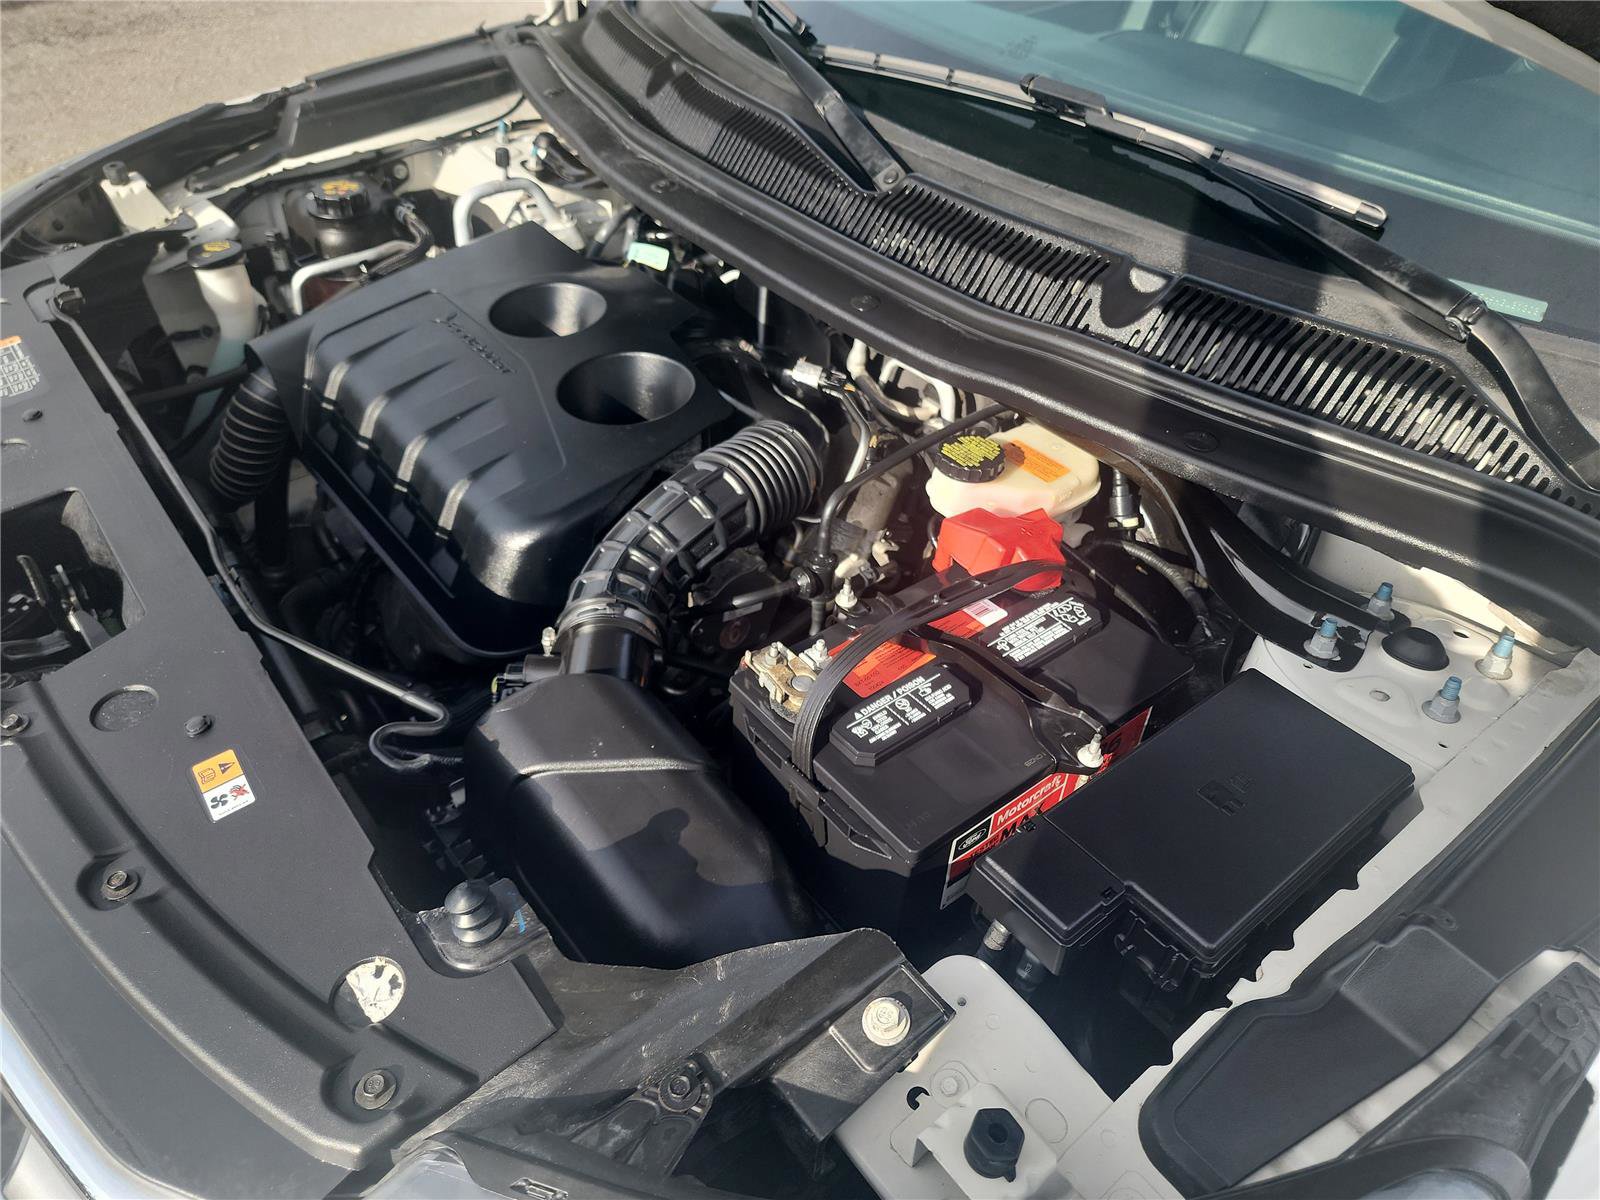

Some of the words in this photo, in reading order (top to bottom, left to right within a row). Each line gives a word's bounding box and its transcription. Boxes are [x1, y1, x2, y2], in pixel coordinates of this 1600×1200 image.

[861, 694, 894, 715] DANGER
[898, 676, 926, 695] POISON
[997, 774, 1063, 827] Motorcraft
[963, 831, 982, 849] Ford
[999, 803, 1045, 840] MAX
